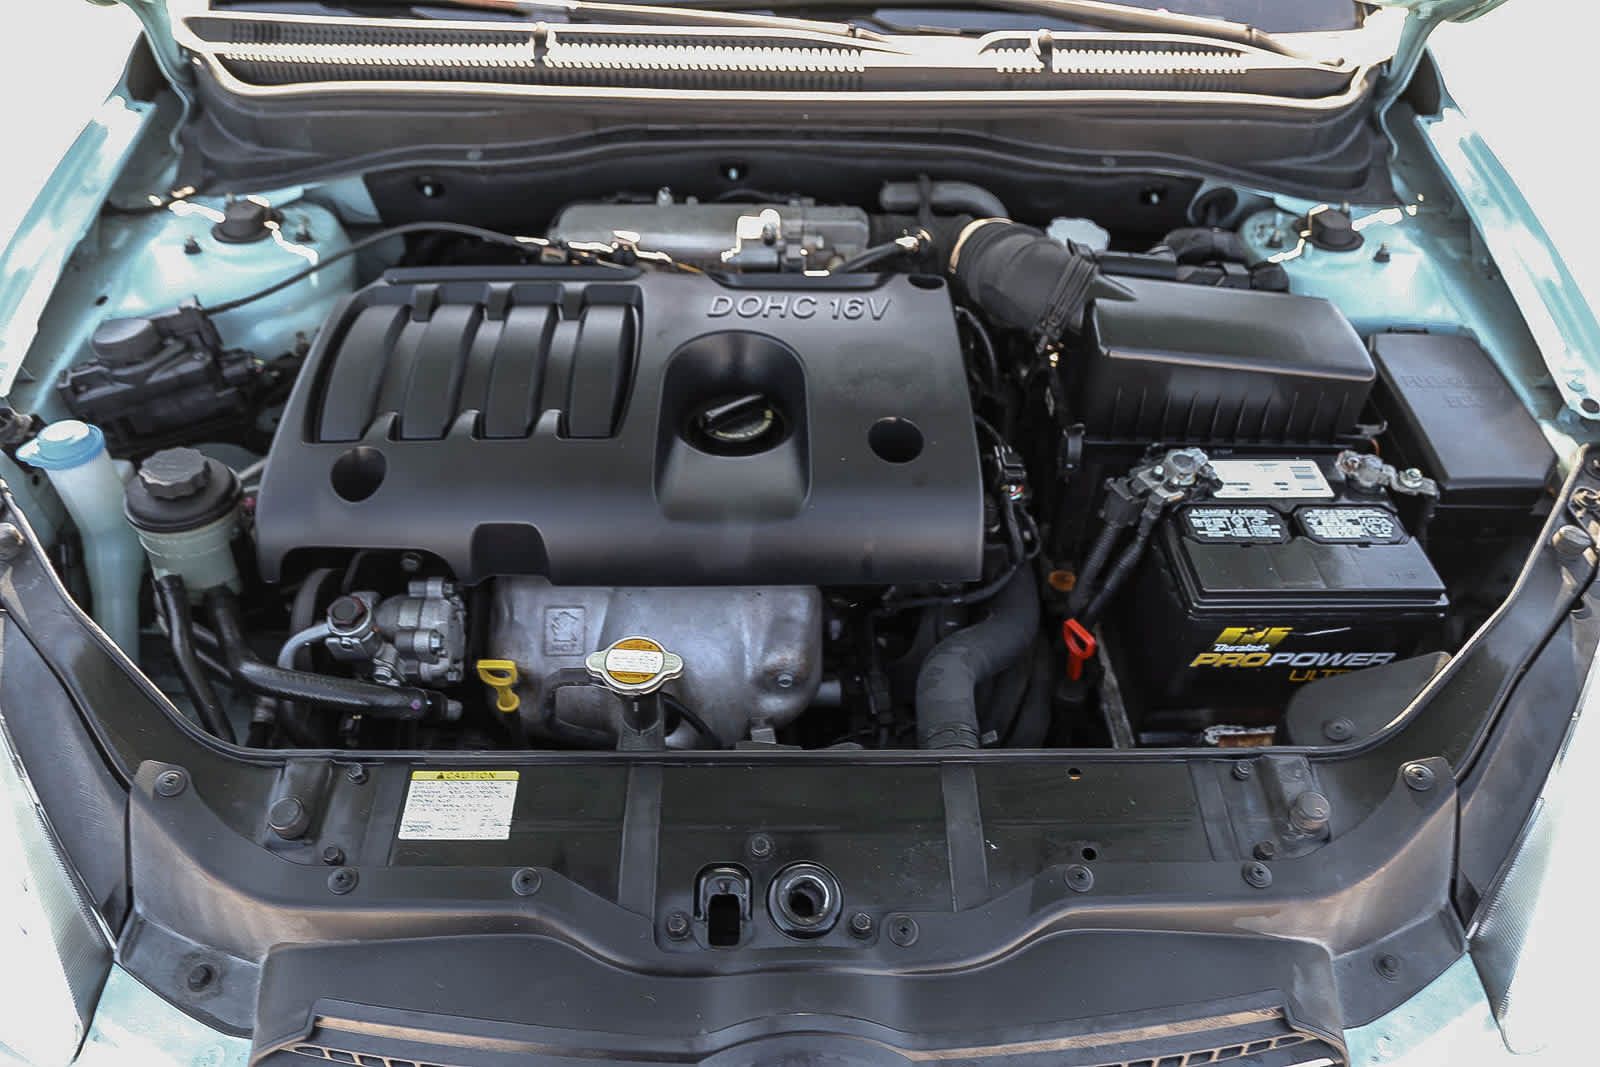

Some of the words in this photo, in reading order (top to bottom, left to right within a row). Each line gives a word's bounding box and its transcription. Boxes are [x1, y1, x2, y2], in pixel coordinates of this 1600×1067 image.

[707, 296, 817, 319] DOHC
[830, 296, 892, 320] 16V
[1288, 669, 1353, 681] ULT
